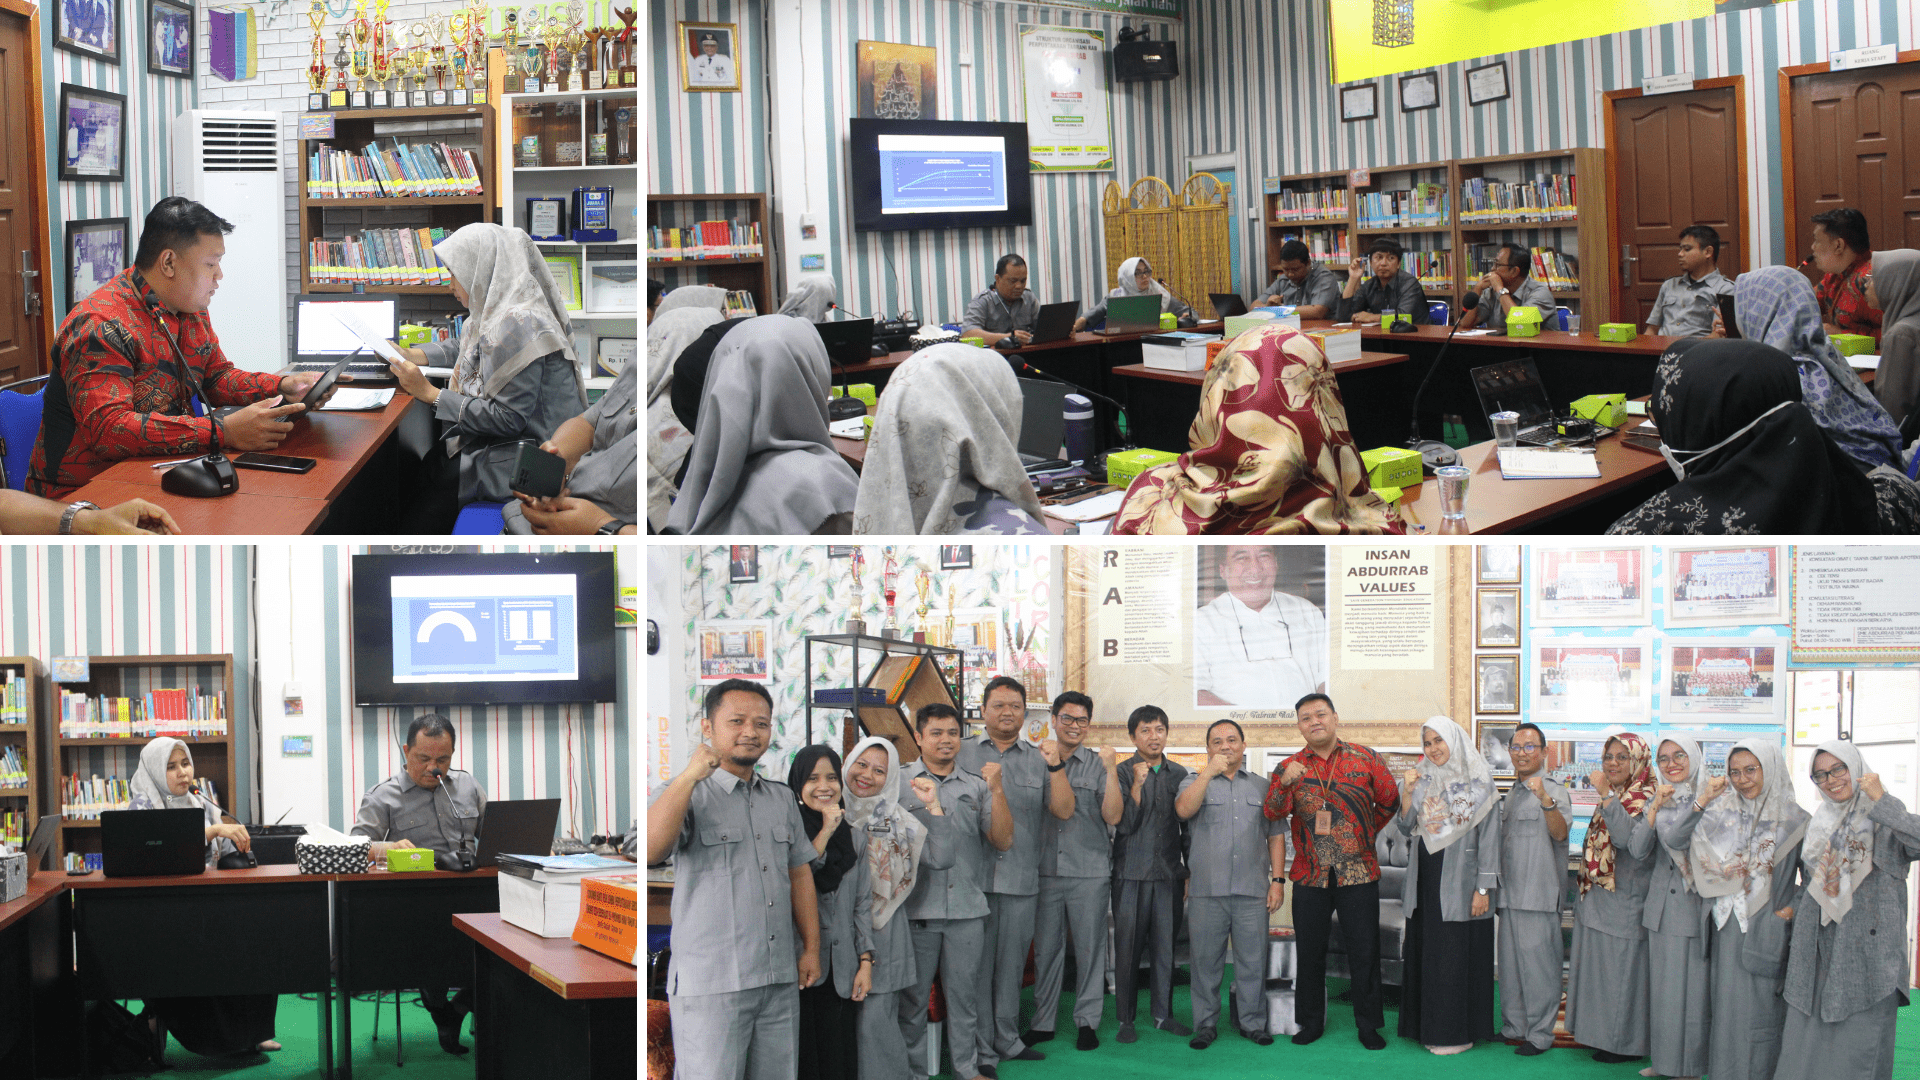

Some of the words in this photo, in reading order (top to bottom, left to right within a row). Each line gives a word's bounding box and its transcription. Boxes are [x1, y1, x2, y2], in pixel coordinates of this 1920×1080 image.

[1103, 550, 1119, 567] R
[1365, 550, 1410, 560] INSAN
[1347, 566, 1428, 577] ABDURRAB
[1360, 582, 1415, 592] VALUES
[1103, 587, 1123, 605] A
[1103, 639, 1118, 657] B
[1250, 711, 1277, 719] Tabrani
